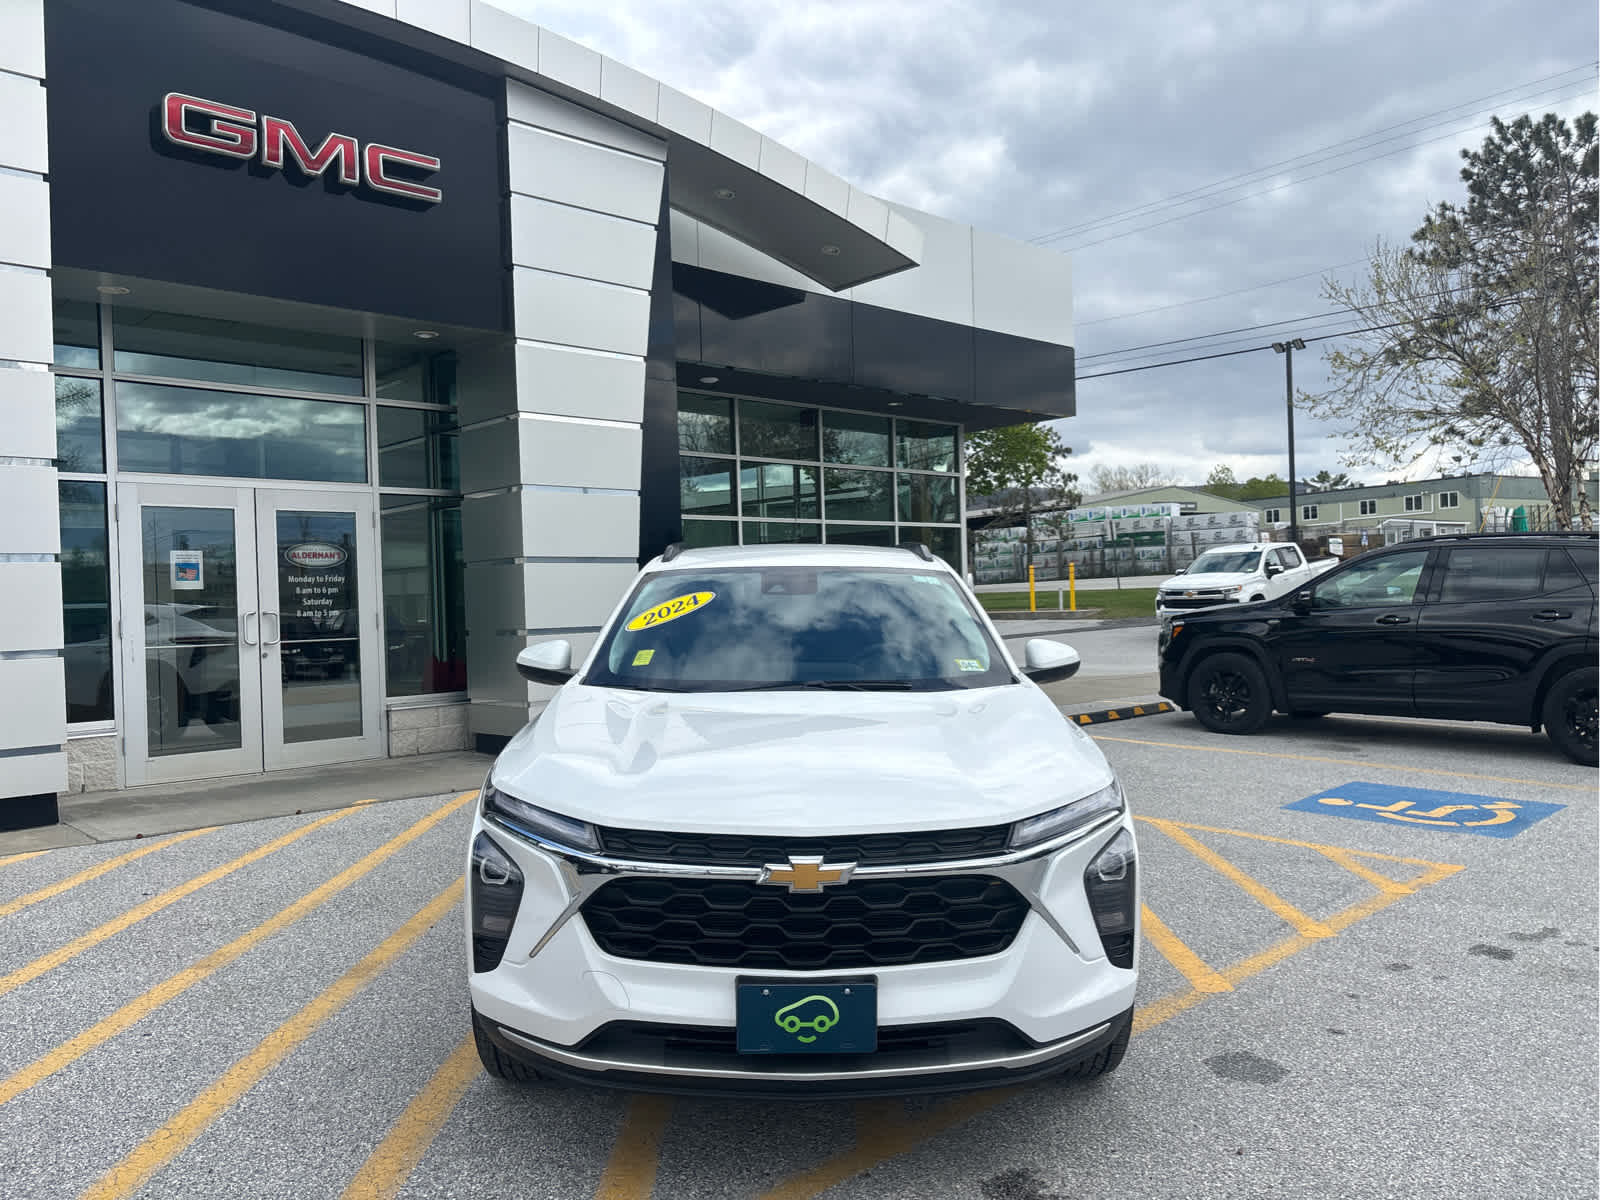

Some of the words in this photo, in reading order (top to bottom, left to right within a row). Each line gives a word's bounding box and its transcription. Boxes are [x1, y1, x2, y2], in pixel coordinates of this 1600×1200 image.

[163, 92, 442, 203] GMC
[291, 551, 342, 560] ALDERMAN'S
[288, 575, 315, 584] Monday
[316, 575, 324, 583] to
[325, 574, 345, 584] Friday
[328, 587, 339, 595] pm
[303, 598, 334, 606] Saturday
[314, 609, 322, 617] to
[328, 609, 340, 618] pm
[643, 595, 701, 626] 2024
